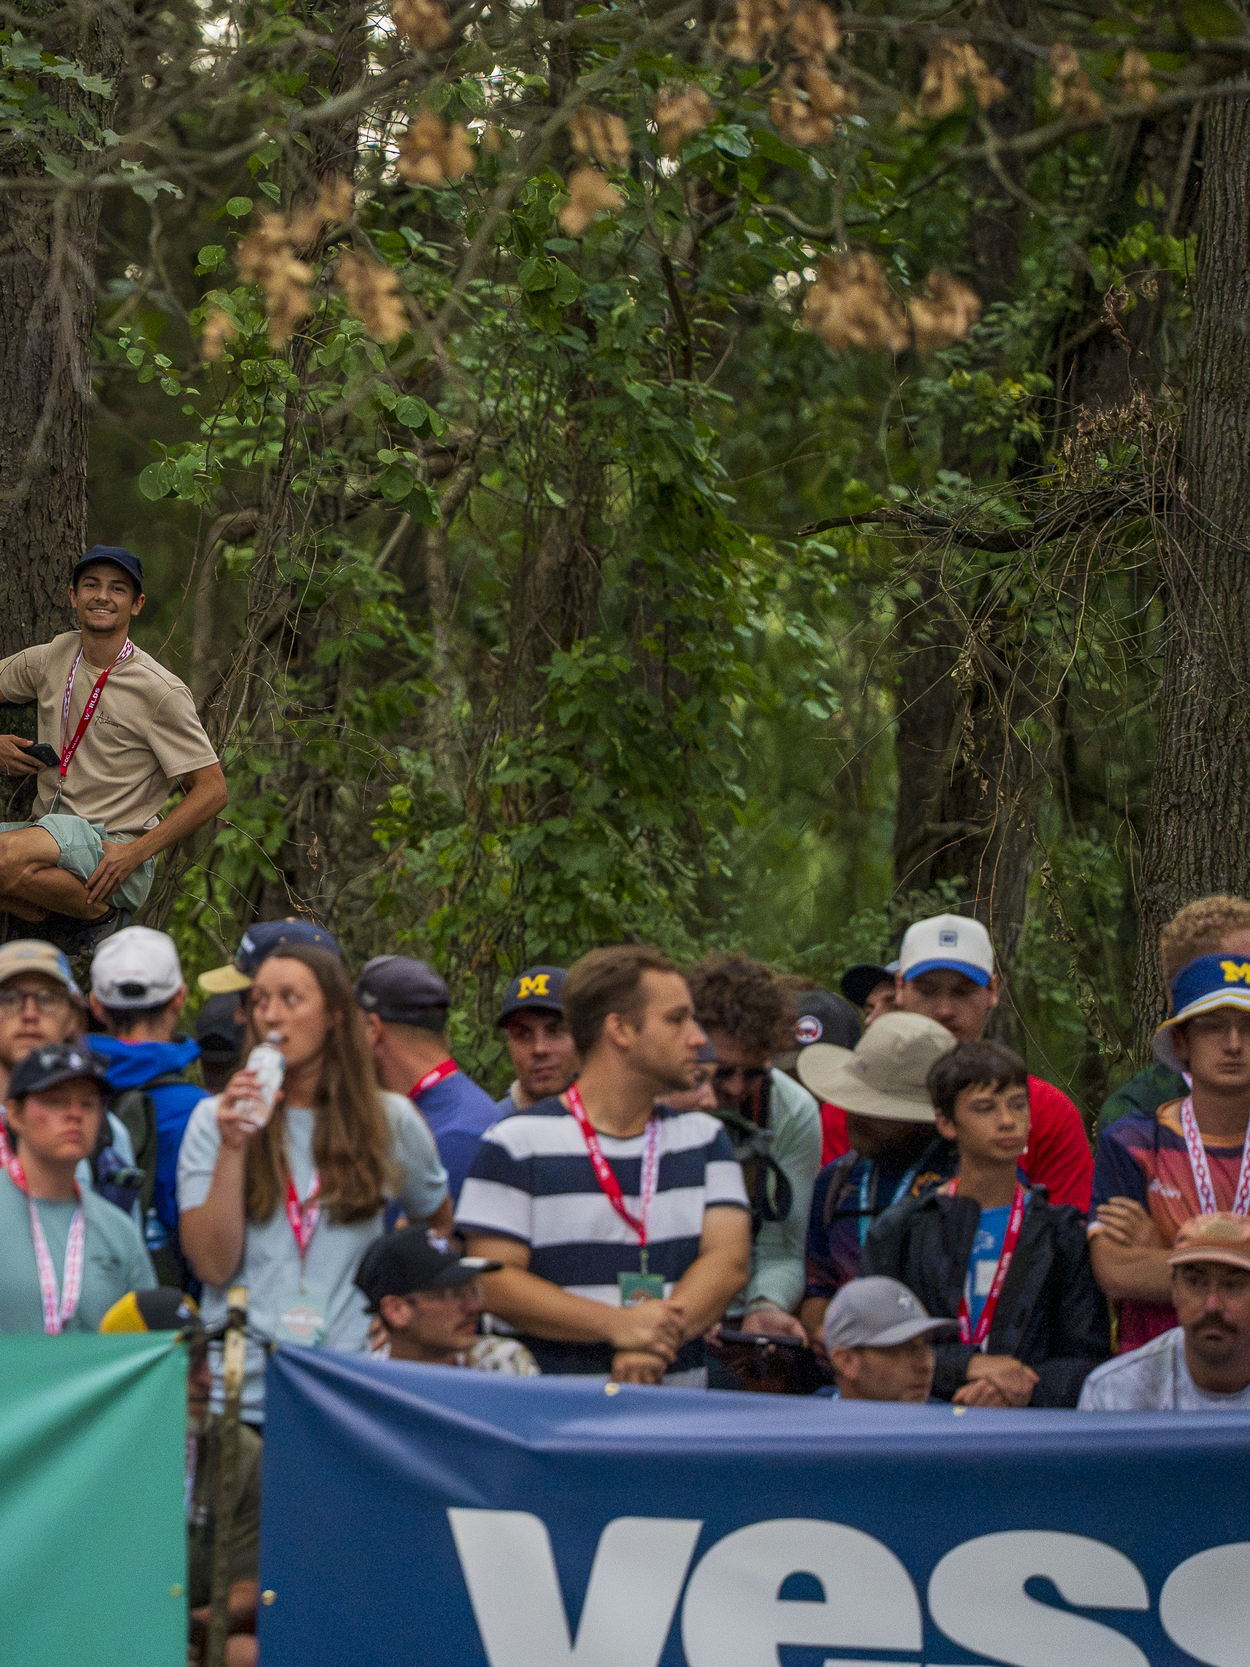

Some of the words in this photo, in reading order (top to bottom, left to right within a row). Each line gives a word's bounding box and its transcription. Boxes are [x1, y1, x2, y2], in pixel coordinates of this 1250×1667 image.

[83, 687, 101, 720] WORLDS
[1220, 961, 1250, 984] M
[517, 974, 550, 999] M
